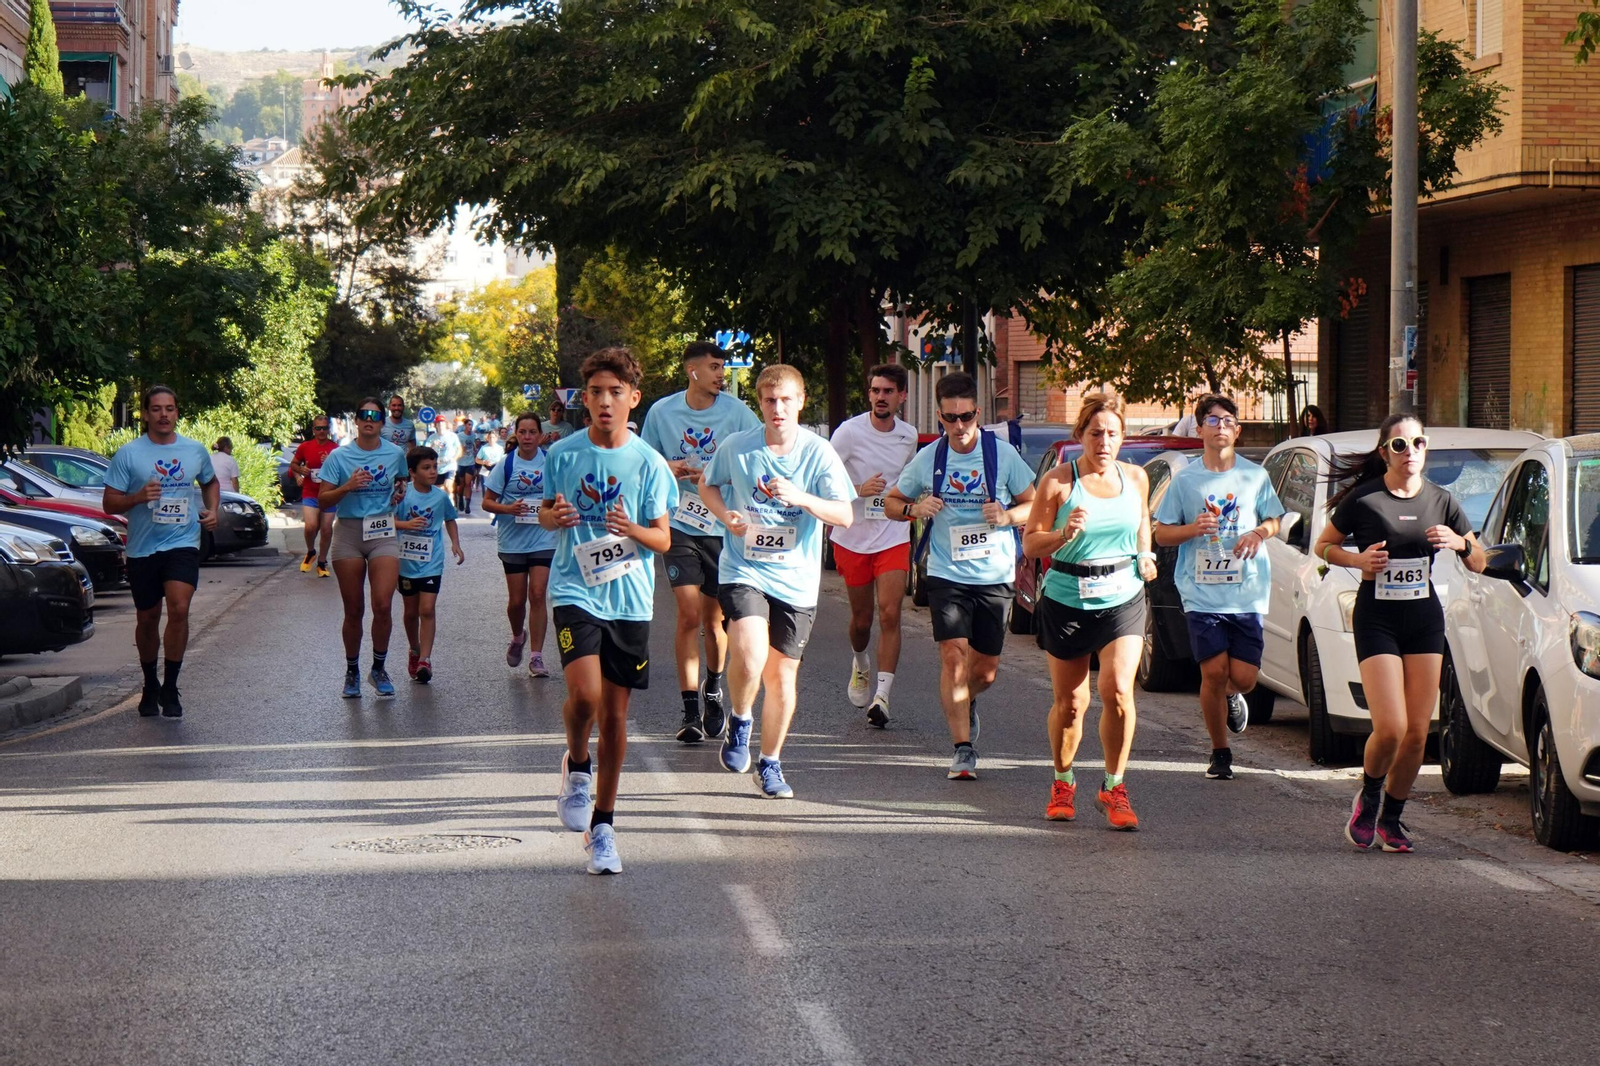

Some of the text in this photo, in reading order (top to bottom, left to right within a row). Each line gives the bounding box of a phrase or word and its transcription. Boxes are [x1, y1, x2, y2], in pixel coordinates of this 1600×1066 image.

[161, 504, 181, 513] 475
[686, 501, 709, 519] 532
[370, 519, 388, 530] 468
[755, 534, 785, 548] 824
[961, 532, 988, 546] 885
[403, 541, 429, 552] 1544
[589, 543, 624, 566] 793
[1205, 559, 1231, 570] 777
[1384, 569, 1424, 583] 1463
